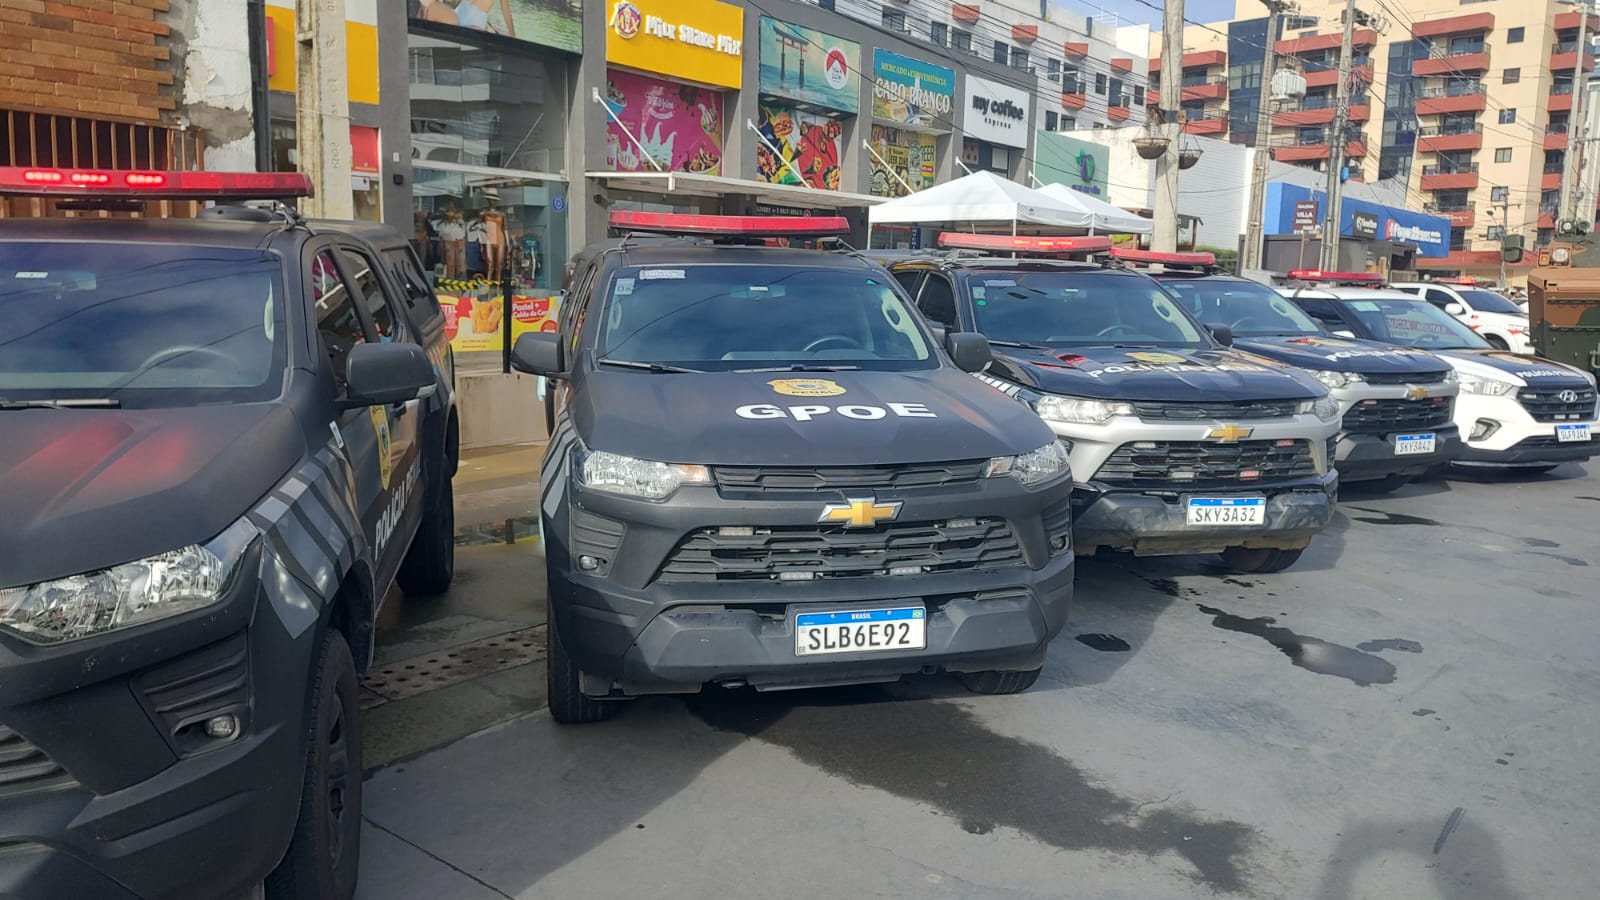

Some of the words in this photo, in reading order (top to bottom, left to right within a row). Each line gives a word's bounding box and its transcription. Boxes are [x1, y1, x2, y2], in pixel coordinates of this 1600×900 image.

[875, 78, 906, 103] CABO
[909, 86, 951, 114] BRANCO
[972, 95, 990, 115] my
[991, 100, 1024, 121] coffee
[512, 302, 534, 312] Pastel
[735, 402, 938, 421] GPOE
[375, 480, 405, 561] POLÍCIA
[1195, 507, 1256, 523] SKY3A32
[808, 622, 911, 651] SLB6E92
